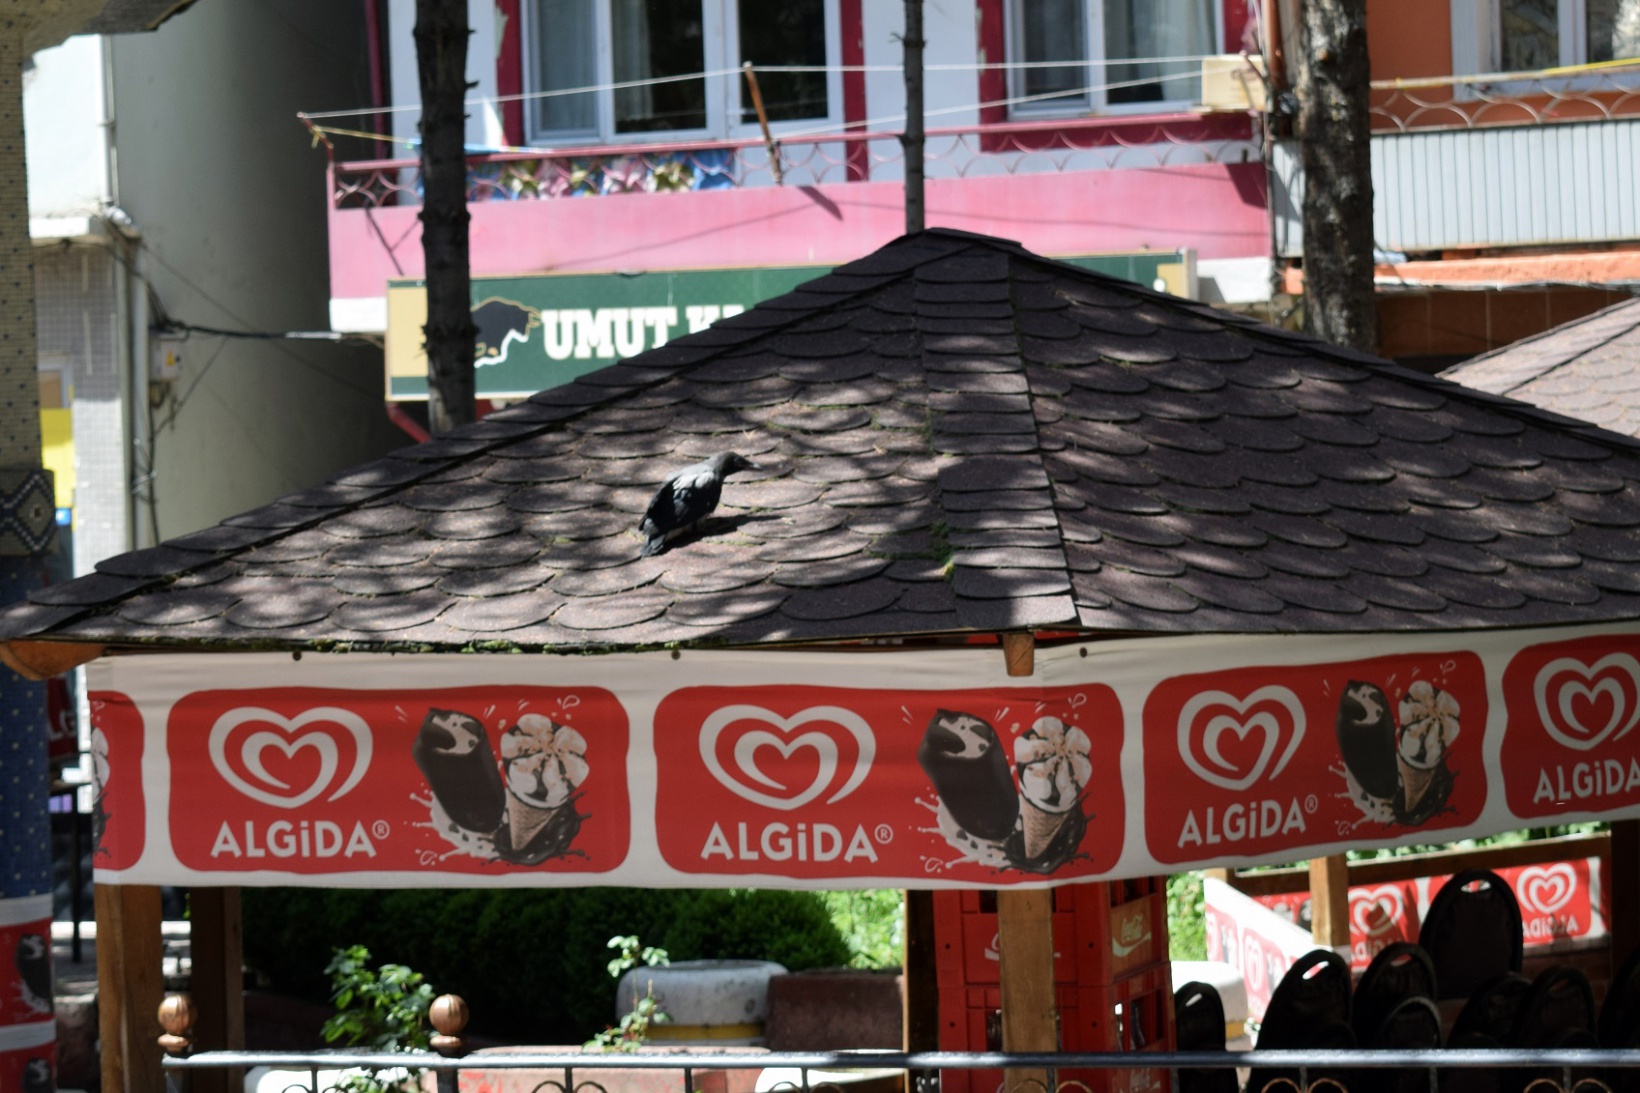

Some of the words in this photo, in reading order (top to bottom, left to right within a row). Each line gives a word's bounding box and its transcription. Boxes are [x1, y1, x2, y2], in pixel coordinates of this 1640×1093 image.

[541, 306, 677, 360] UMUT
[686, 304, 745, 334] K
[1532, 755, 1640, 805] ALGiDA
